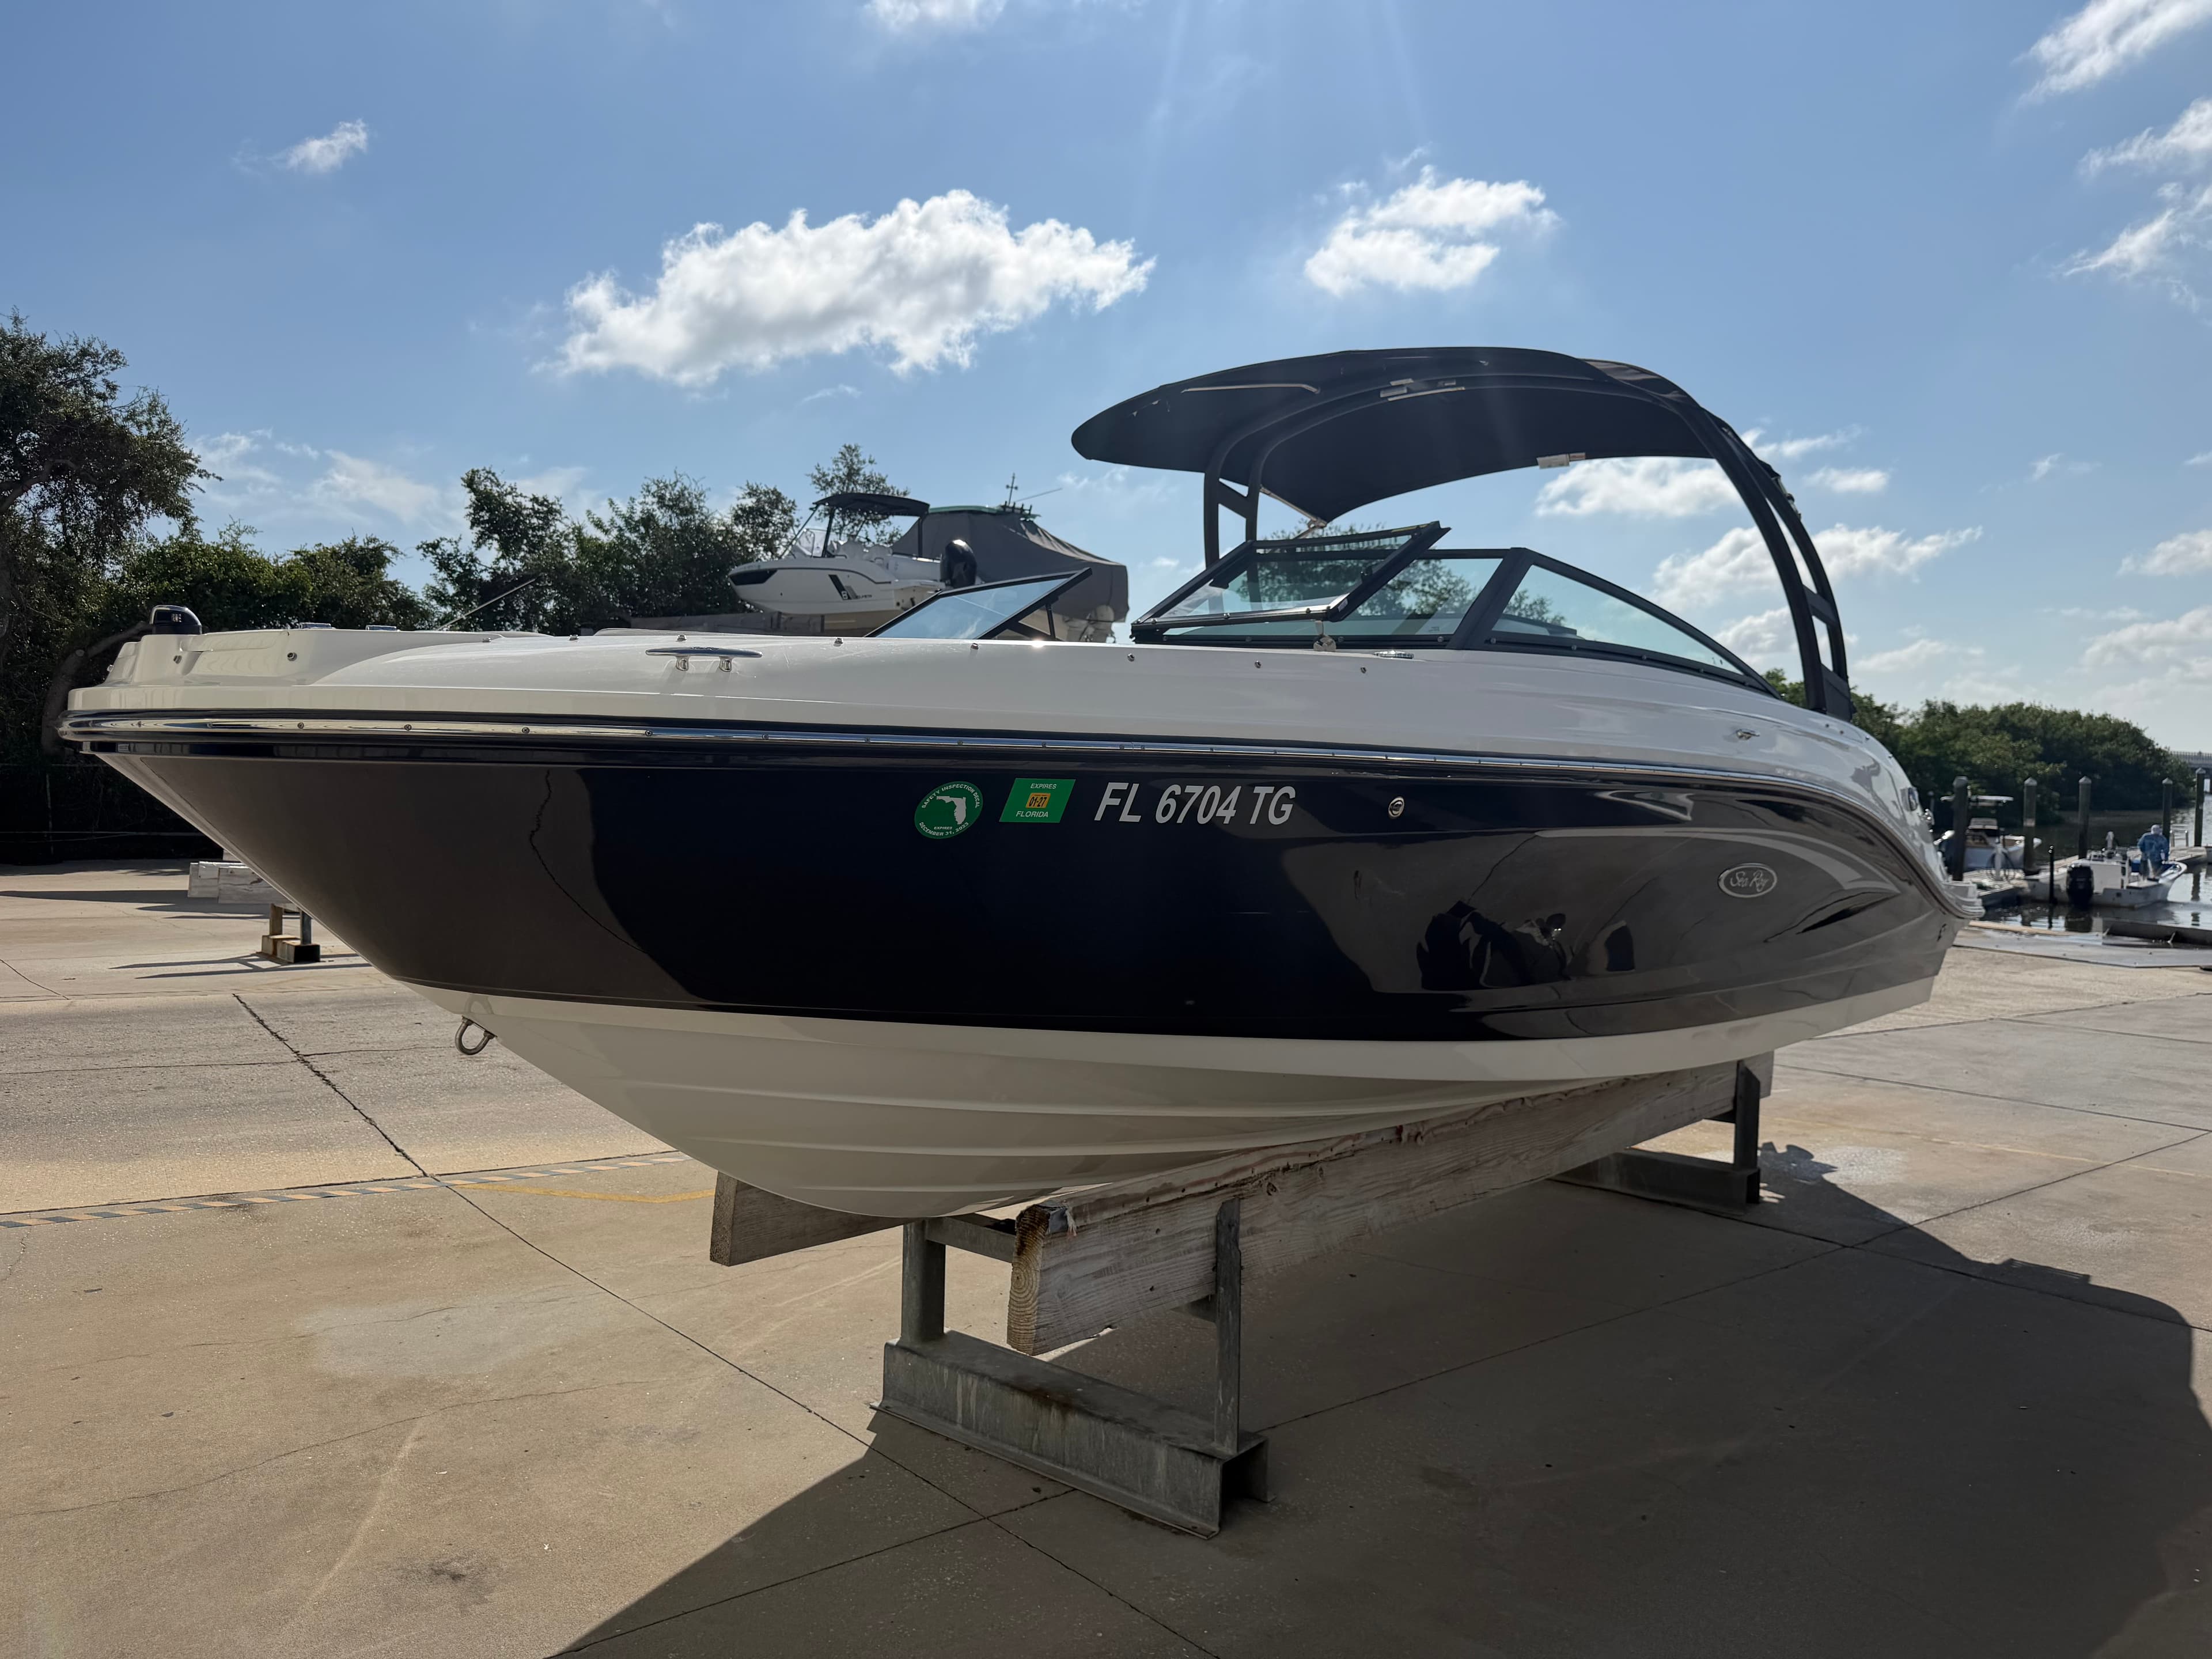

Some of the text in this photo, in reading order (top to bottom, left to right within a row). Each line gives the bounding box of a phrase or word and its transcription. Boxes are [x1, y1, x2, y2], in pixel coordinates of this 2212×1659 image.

[922, 790, 940, 808] SAFETY
[942, 783, 975, 793] INSPECTION
[1029, 797, 1047, 807] 01-27
[1094, 782, 1296, 825] FL 6704 TG
[919, 822, 944, 836] DECEMBER
[955, 822, 969, 832] 2023
[1730, 870, 1769, 892] Sea Ray
